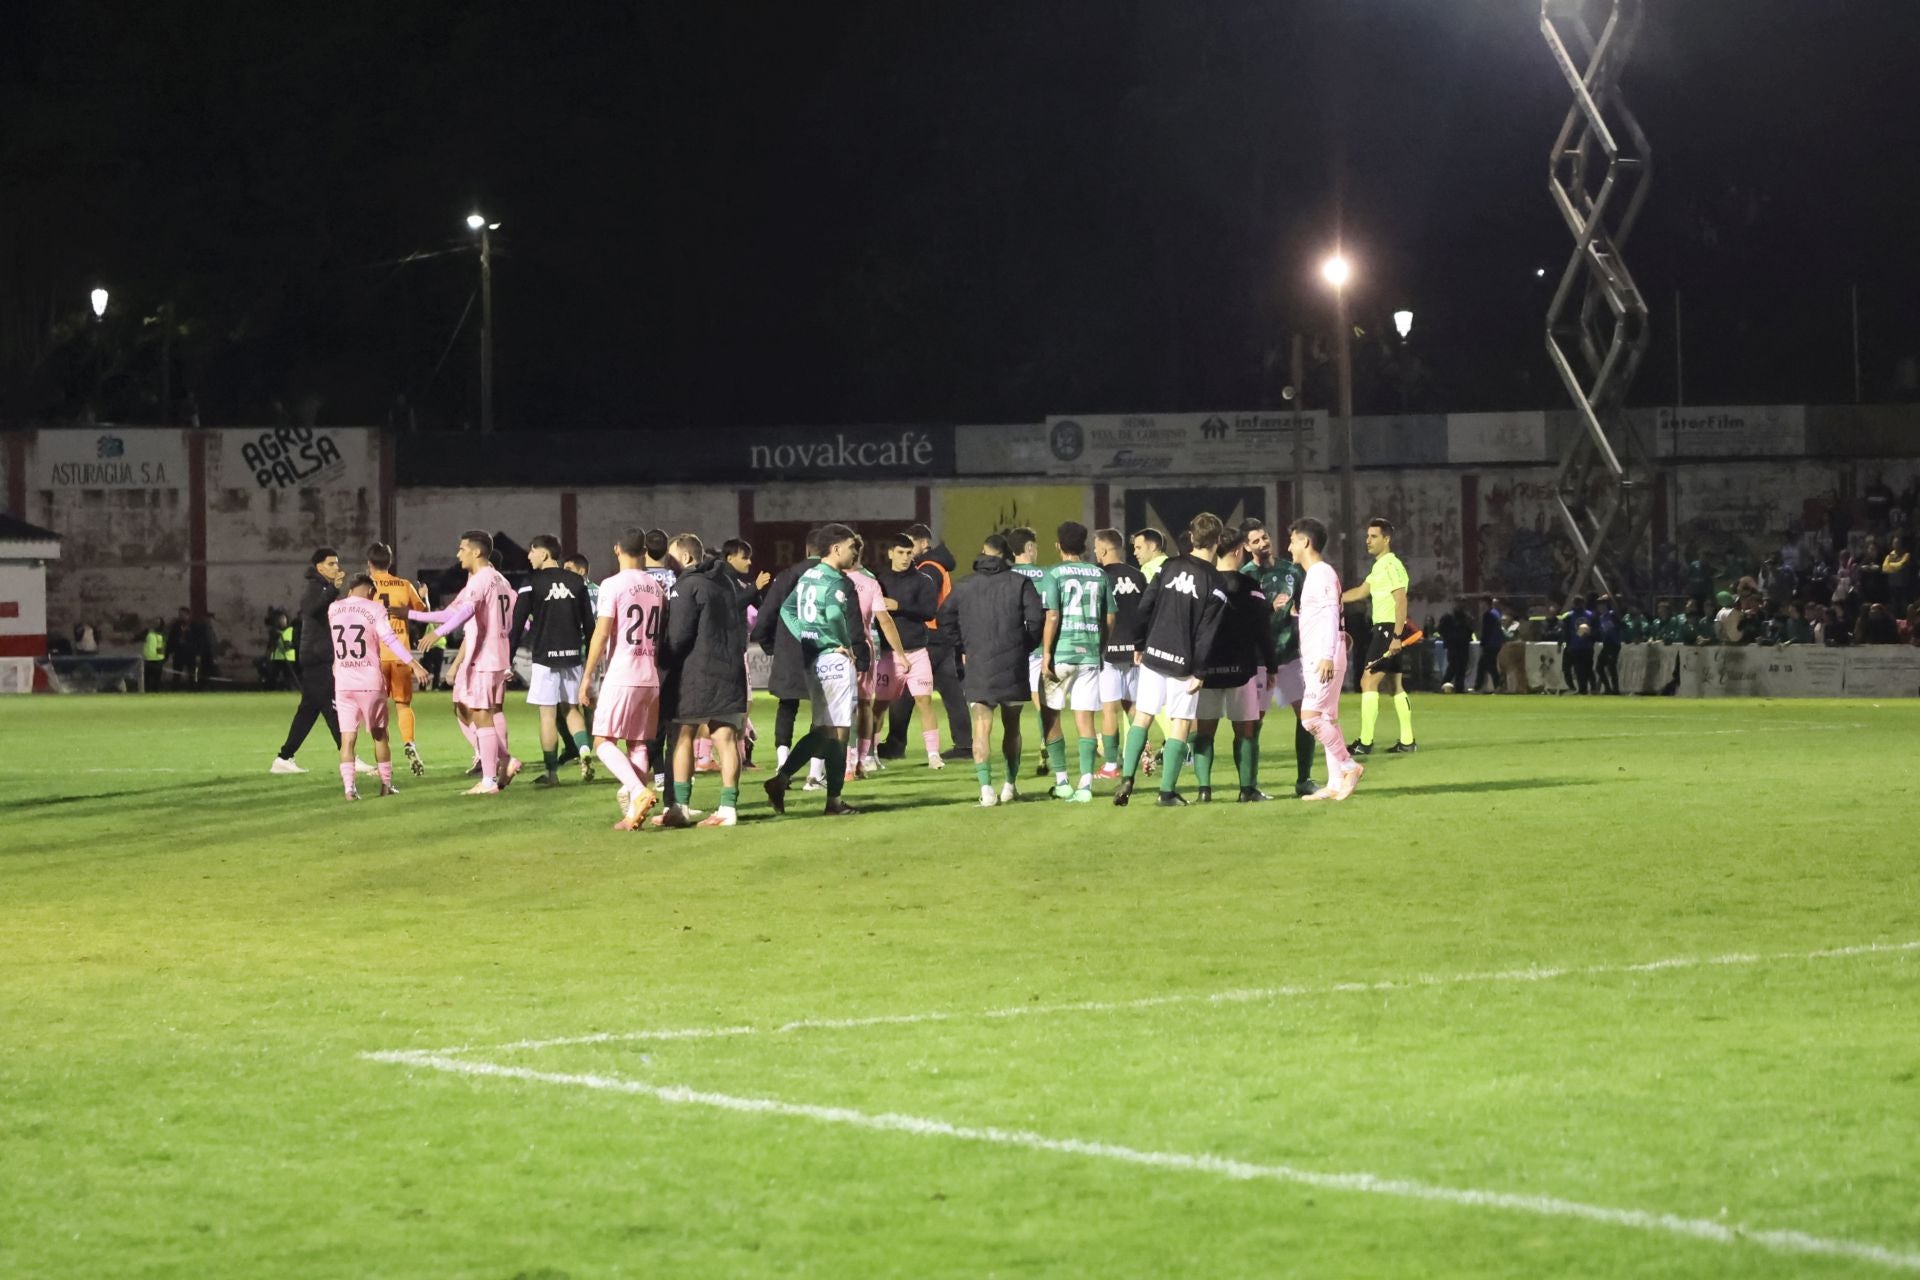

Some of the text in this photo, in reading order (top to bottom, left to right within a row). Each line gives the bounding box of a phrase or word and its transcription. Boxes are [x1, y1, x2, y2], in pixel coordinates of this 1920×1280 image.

[255, 436, 341, 489] PALSA
[750, 431, 934, 469] novakcafé
[1058, 566, 1102, 577] MATHEUS
[629, 584, 655, 597] CARLOS
[797, 582, 818, 624] 18
[1062, 578, 1099, 618] 21
[348, 606, 376, 625] MARCOS
[625, 604, 661, 647] 24
[332, 624, 367, 660] 33
[340, 660, 372, 668] ABANCA
